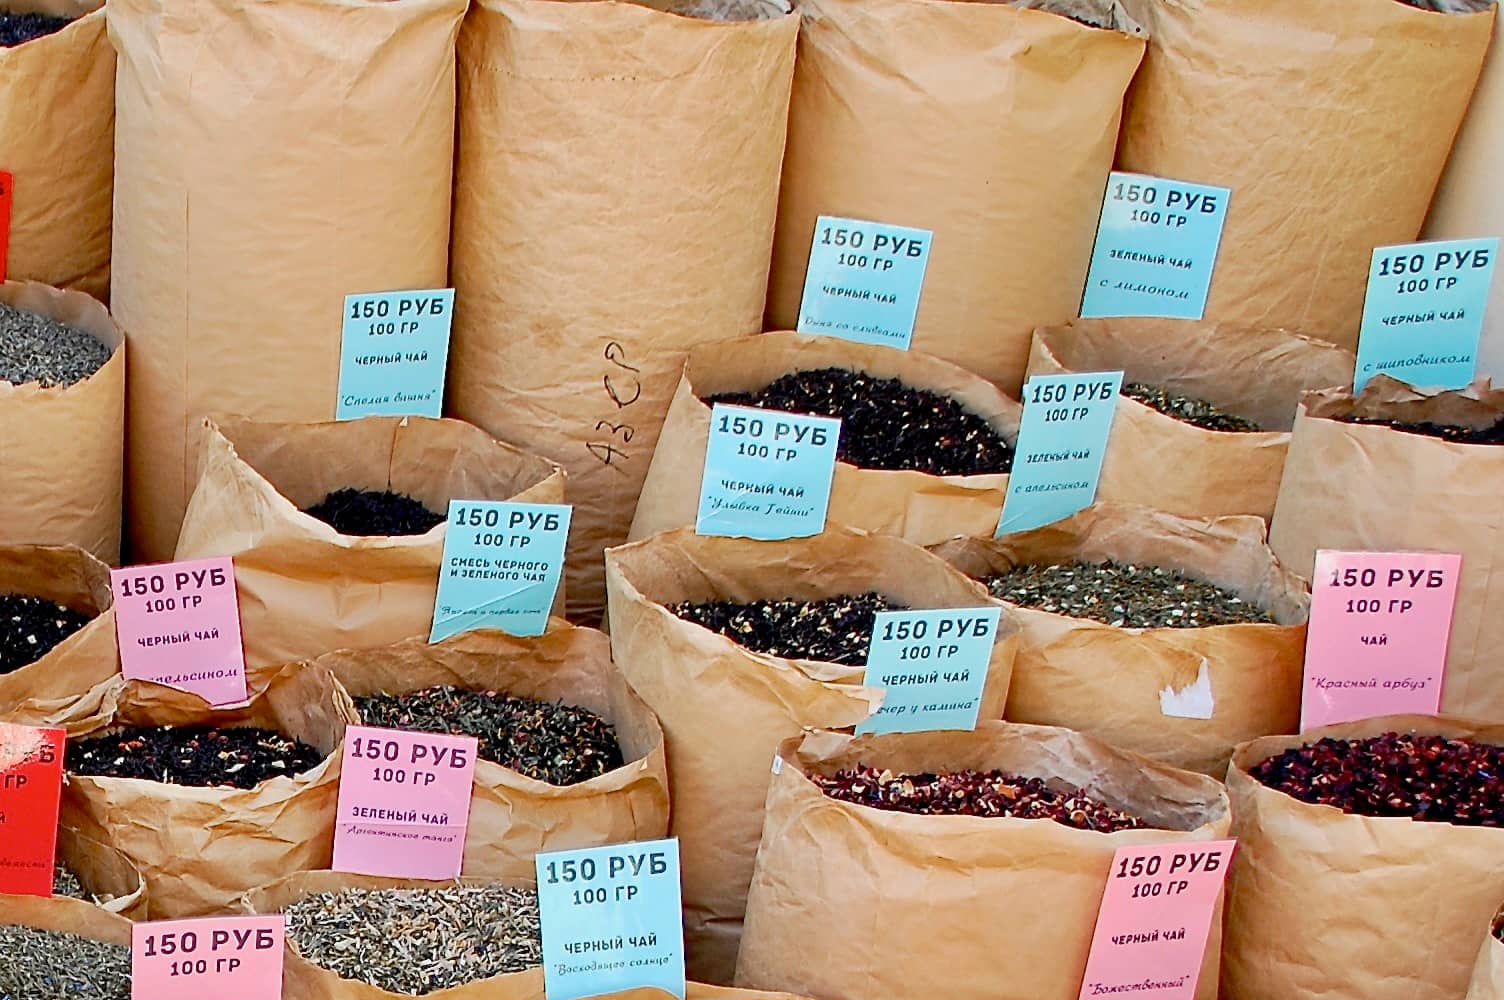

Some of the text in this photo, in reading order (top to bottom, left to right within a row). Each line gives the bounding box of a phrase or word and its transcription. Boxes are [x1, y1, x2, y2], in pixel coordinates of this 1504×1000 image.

[821, 227, 923, 258] 150 РУБ
[1110, 249, 1193, 270] ЗЕЛЕНЫЙ ЧАЙ
[1378, 249, 1489, 277] 150 РУБ
[1099, 279, 1189, 300] с лимоном
[355, 350, 428, 365] ЧЕРНЫЙ ЧАЙ
[1362, 353, 1471, 373] с шиповником
[1031, 382, 1113, 404] 150 РУБ
[737, 442, 797, 462] 100 ГР
[1014, 485, 1023, 494] с
[450, 557, 549, 572] СМЕСЬ ЧЕРНОГО
[121, 567, 226, 597] 150 РУБ
[450, 568, 546, 583] И ЗЕЛЕНОГО ЧАЯ
[1330, 568, 1443, 588] 150 РУБ
[881, 671, 970, 686] ЧЕРНЫЙ ЧАЙ
[352, 806, 449, 825] ЗЕЛЕНЫЙ ЧАЙ
[546, 852, 667, 884] 150 РУБ
[1131, 880, 1189, 898] 100 ГР
